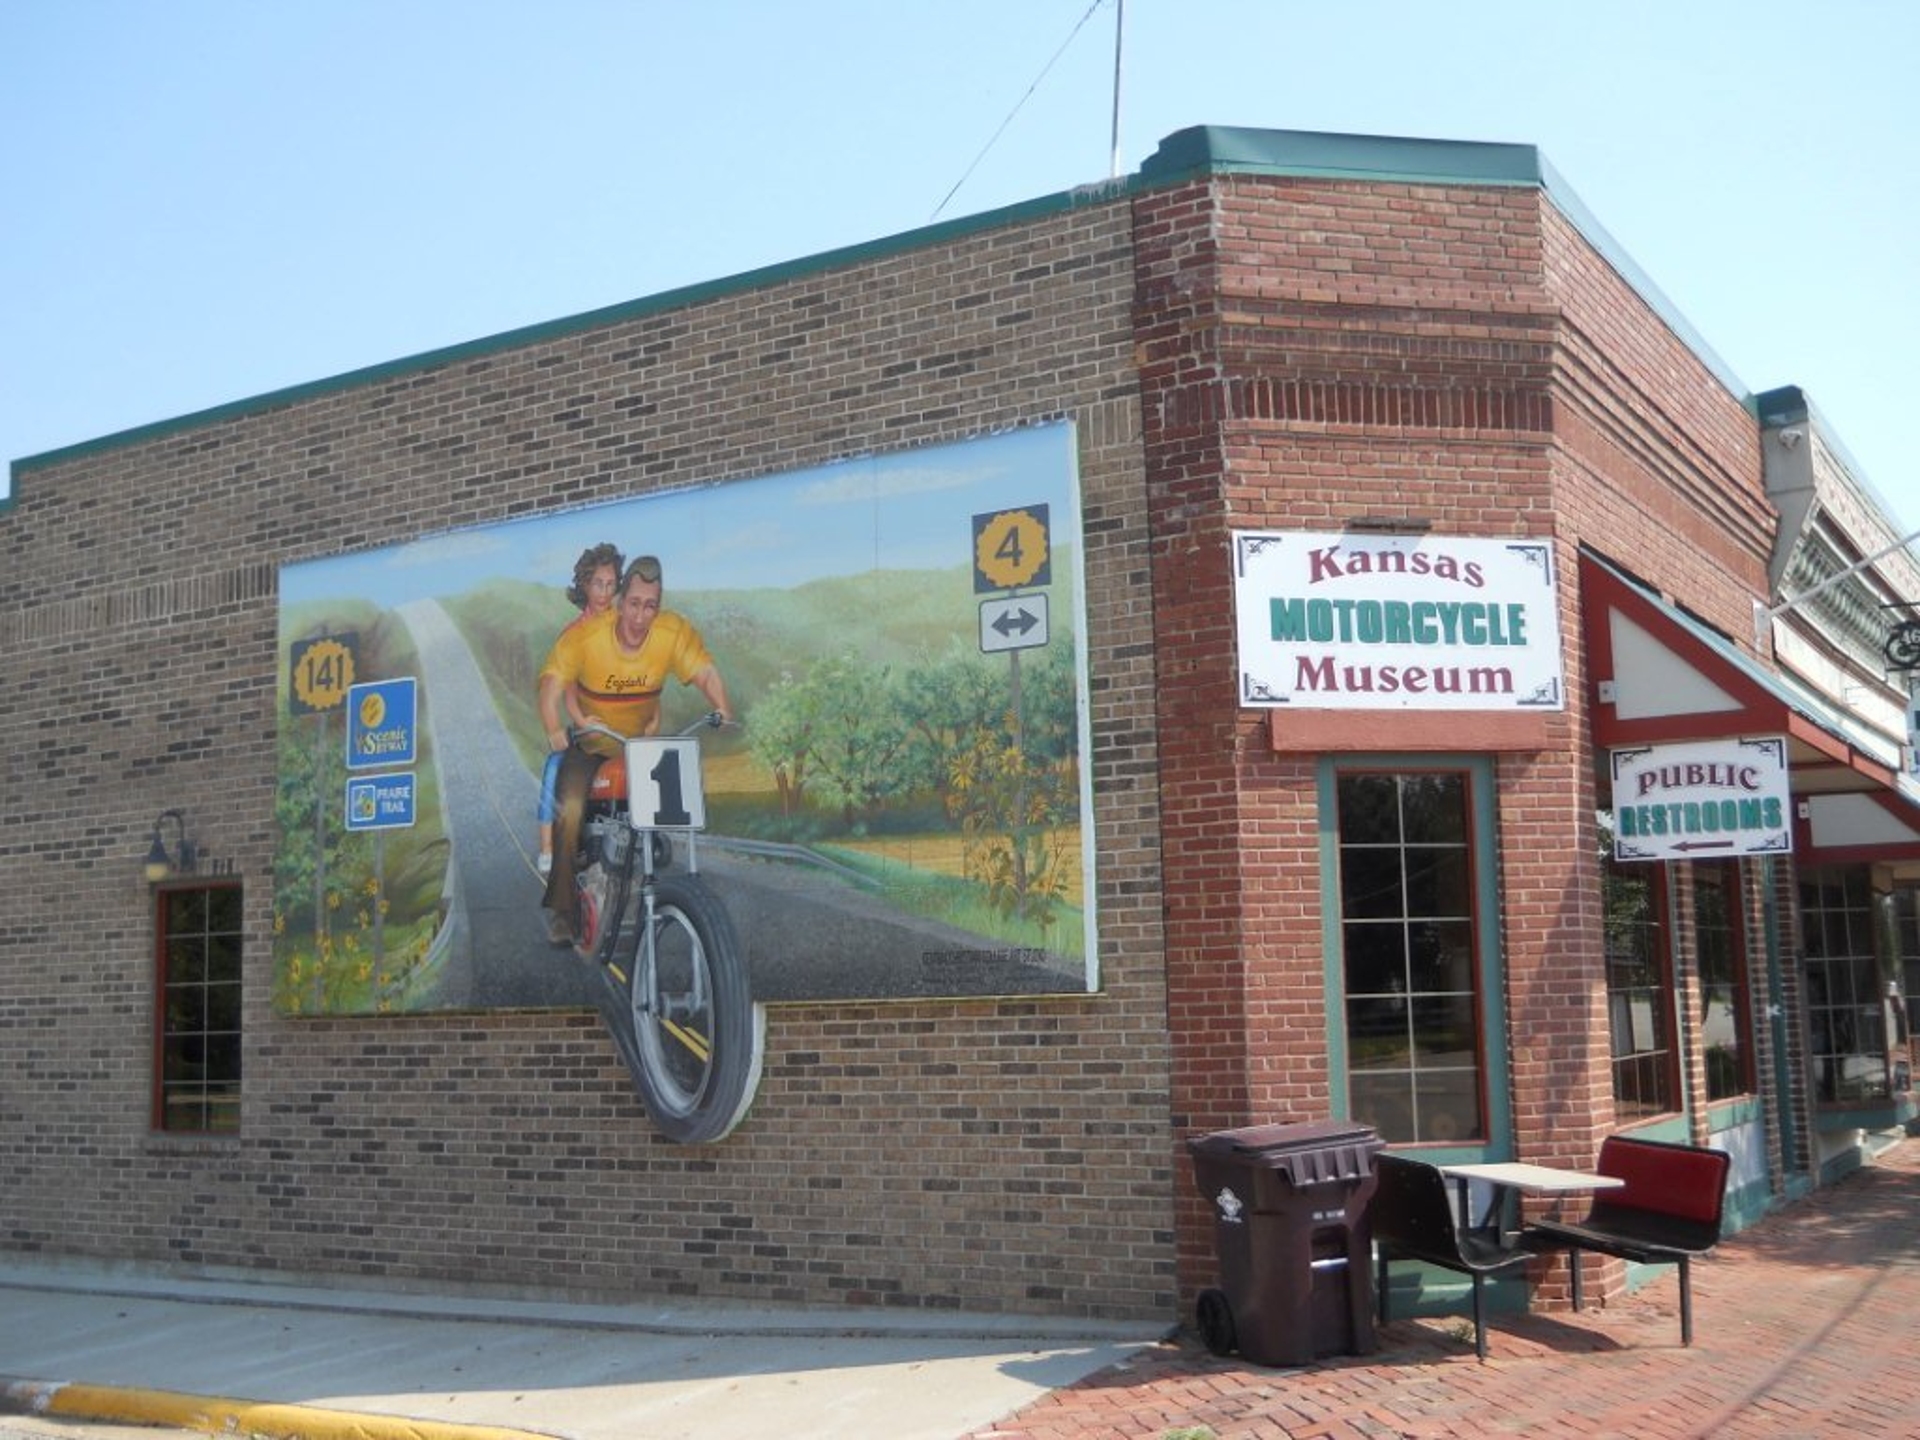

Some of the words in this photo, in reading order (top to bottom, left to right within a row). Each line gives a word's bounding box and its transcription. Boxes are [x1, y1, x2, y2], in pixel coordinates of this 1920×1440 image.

[994, 525, 1024, 567] 4
[1308, 545, 1485, 588] Kansas
[1269, 597, 1527, 646] MOTORCYCLE
[307, 654, 344, 693] 141
[1294, 655, 1514, 693] Museum
[650, 748, 691, 825] 1
[1637, 764, 1759, 796] PUBLIC
[1619, 797, 1783, 837] RESTROOMS
